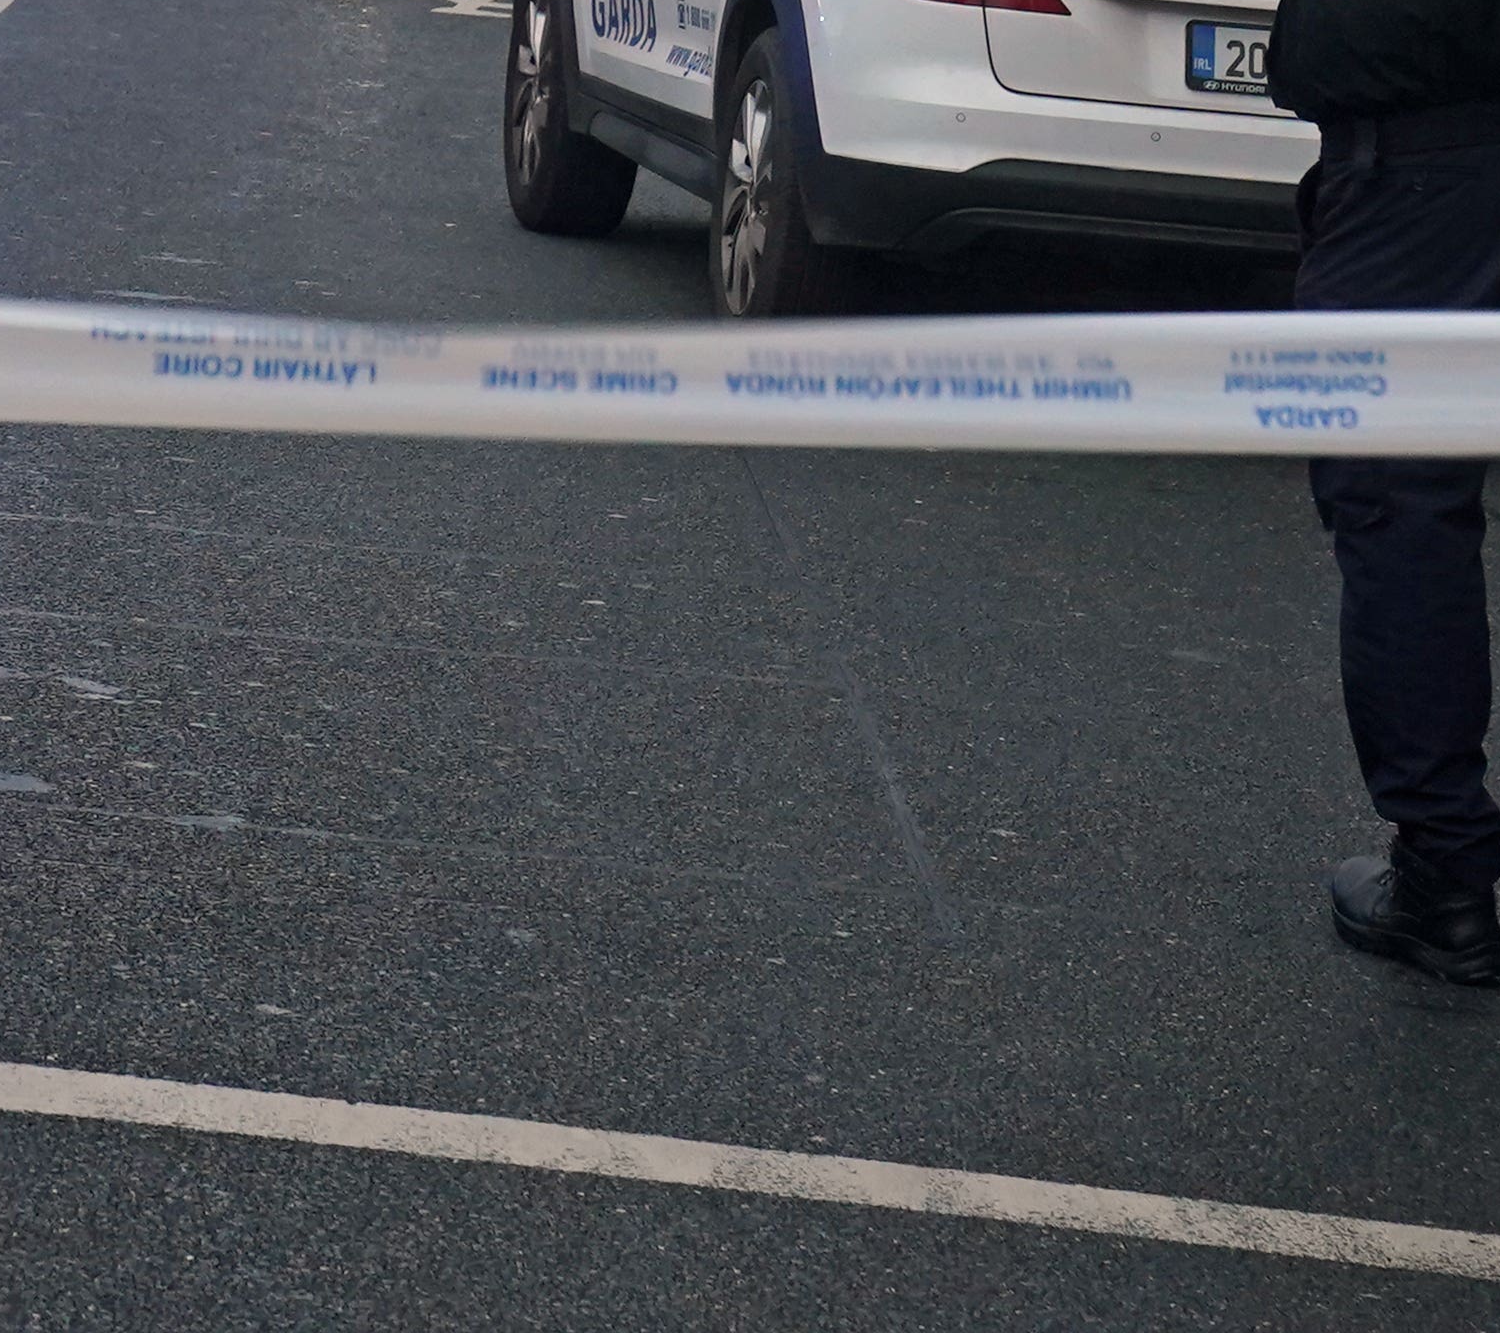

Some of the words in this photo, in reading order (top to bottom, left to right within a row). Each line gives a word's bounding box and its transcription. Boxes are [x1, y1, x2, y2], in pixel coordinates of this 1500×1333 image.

[1193, 57, 1213, 71] IRL
[155, 351, 243, 378] COIRE
[254, 356, 377, 386] LÁTHAIR
[482, 365, 577, 391] SCENE
[588, 370, 678, 394] CRIME
[1225, 374, 1387, 396] Confidential
[1255, 406, 1359, 429] GARDA
